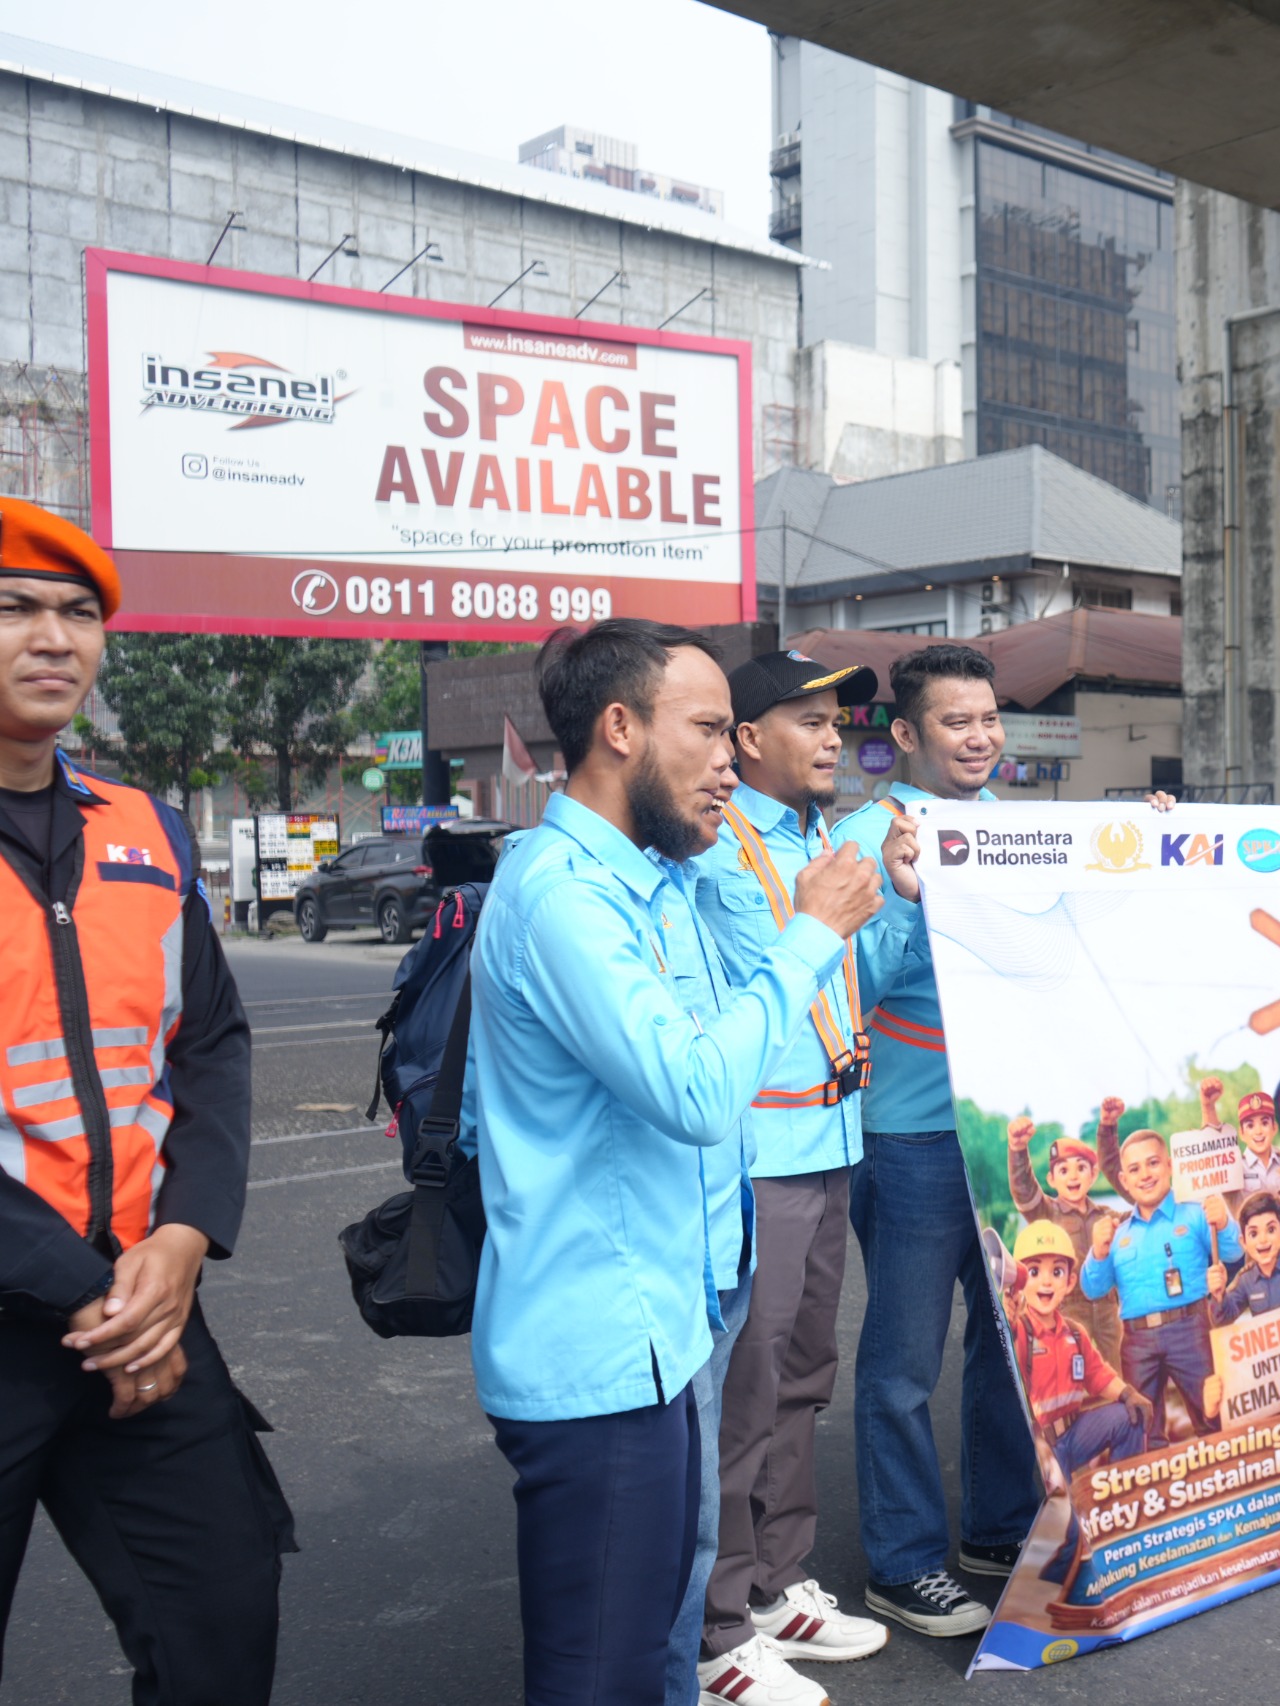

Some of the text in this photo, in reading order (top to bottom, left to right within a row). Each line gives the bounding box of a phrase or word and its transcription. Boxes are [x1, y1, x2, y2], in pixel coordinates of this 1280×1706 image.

[470, 333, 629, 366] www.insaneadv.com
[140, 389, 335, 424] ADVERTISING
[422, 365, 678, 459] SPACE
[212, 467, 305, 487] @insaneadv
[375, 445, 721, 527] AVAILABLE
[470, 529, 498, 549] for
[503, 533, 546, 554] your
[552, 538, 656, 559] promotion
[345, 574, 612, 623] 0811 8088 999
[975, 829, 1073, 847] Danantara
[1161, 833, 1224, 866] KAI
[977, 848, 1068, 866] Indonesia
[1173, 1135, 1239, 1159] KESELAMATAN
[1179, 1151, 1236, 1175] PRIORITAS
[1192, 1171, 1229, 1191] KAMI!
[1142, 1487, 1166, 1517] &
[1103, 1541, 1142, 1565] Peran
[1143, 1516, 1206, 1549] Strategis
[1207, 1503, 1246, 1527] SPKA
[1138, 1533, 1216, 1572] Keselamatan
[1161, 1570, 1220, 1600] menjadikan
[1219, 1548, 1280, 1580] keselamatan
